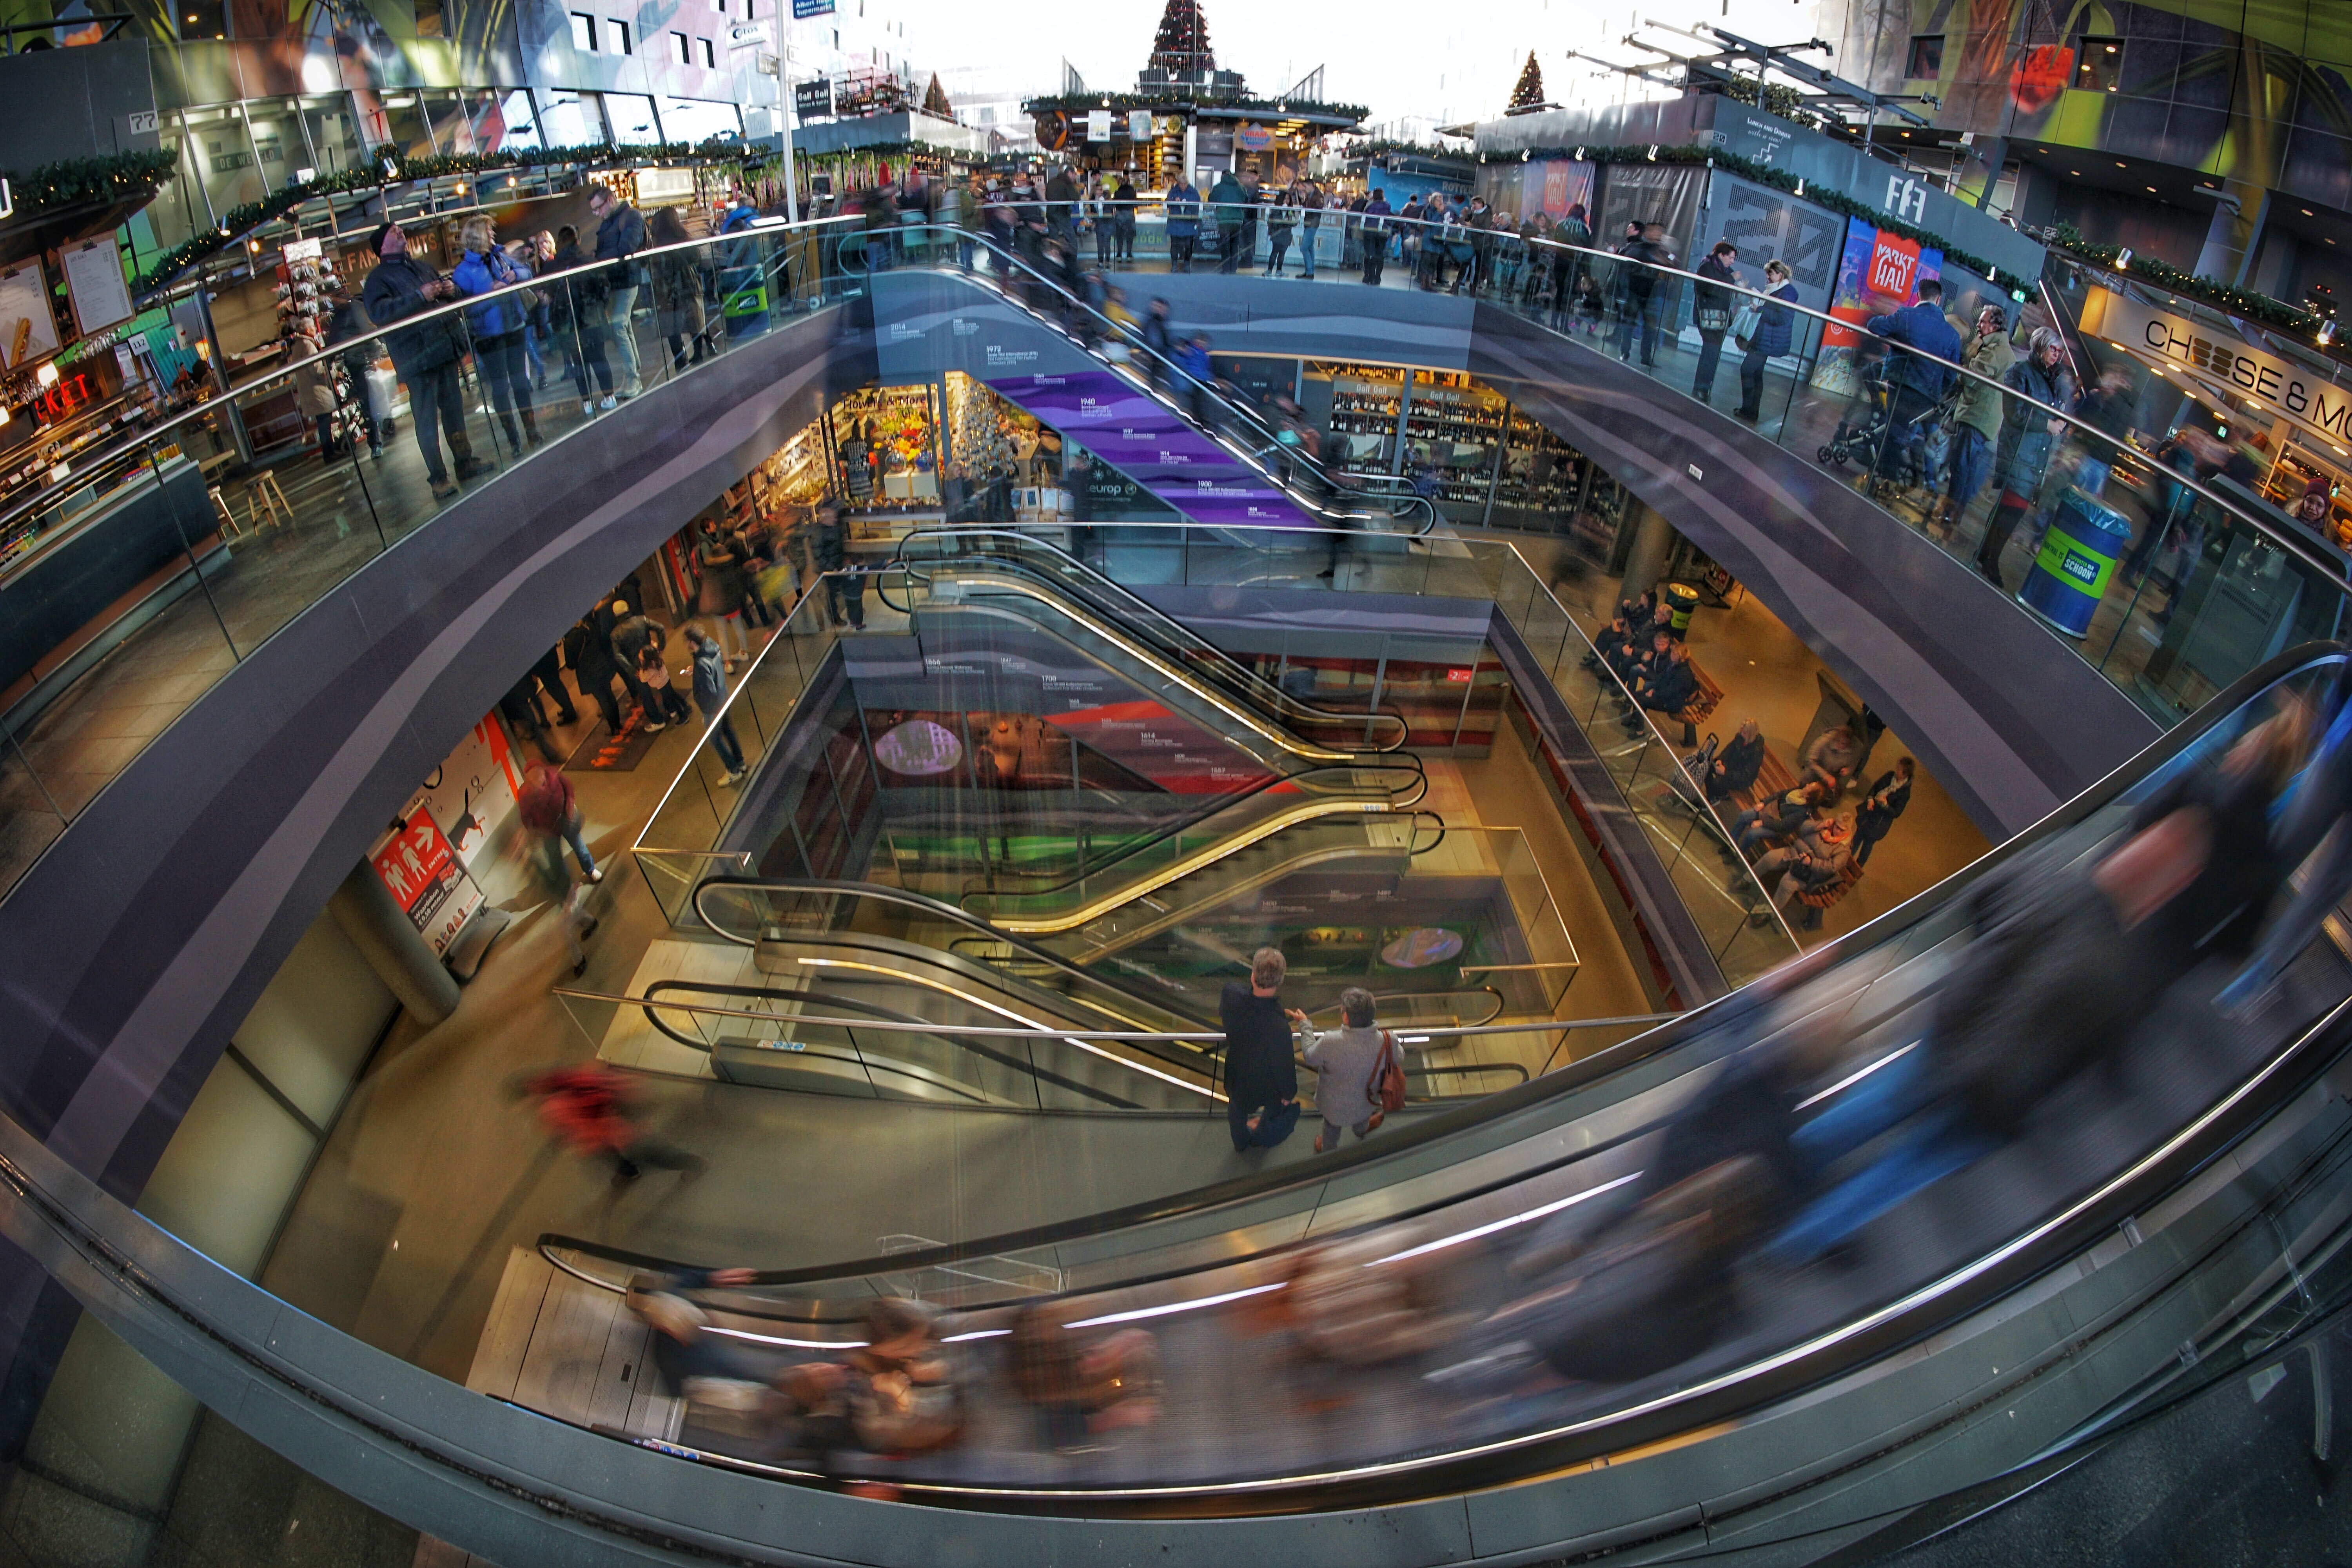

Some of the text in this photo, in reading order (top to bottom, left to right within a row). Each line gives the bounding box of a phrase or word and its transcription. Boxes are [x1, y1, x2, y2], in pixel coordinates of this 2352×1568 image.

[798, 88, 829, 102] Gall Gall
[816, 99, 829, 107] Spirits
[131, 114, 155, 131] 77
[1748, 129, 1761, 138] with
[219, 158, 231, 169] DE
[1725, 183, 1838, 290] 20
[1876, 243, 1915, 270] MARKT
[1875, 260, 1906, 294] HAL
[133, 339, 146, 349] 112
[1356, 384, 1387, 395] Gall Gall
[1430, 391, 1459, 402] Gall Gall
[1483, 397, 1496, 406] Gall
[2286, 381, 2308, 413] &
[2058, 552, 2064, 560] IS
[2064, 558, 2092, 580] SCHOON
[414, 888, 439, 920] Waardebon
[430, 891, 444, 910] retour
